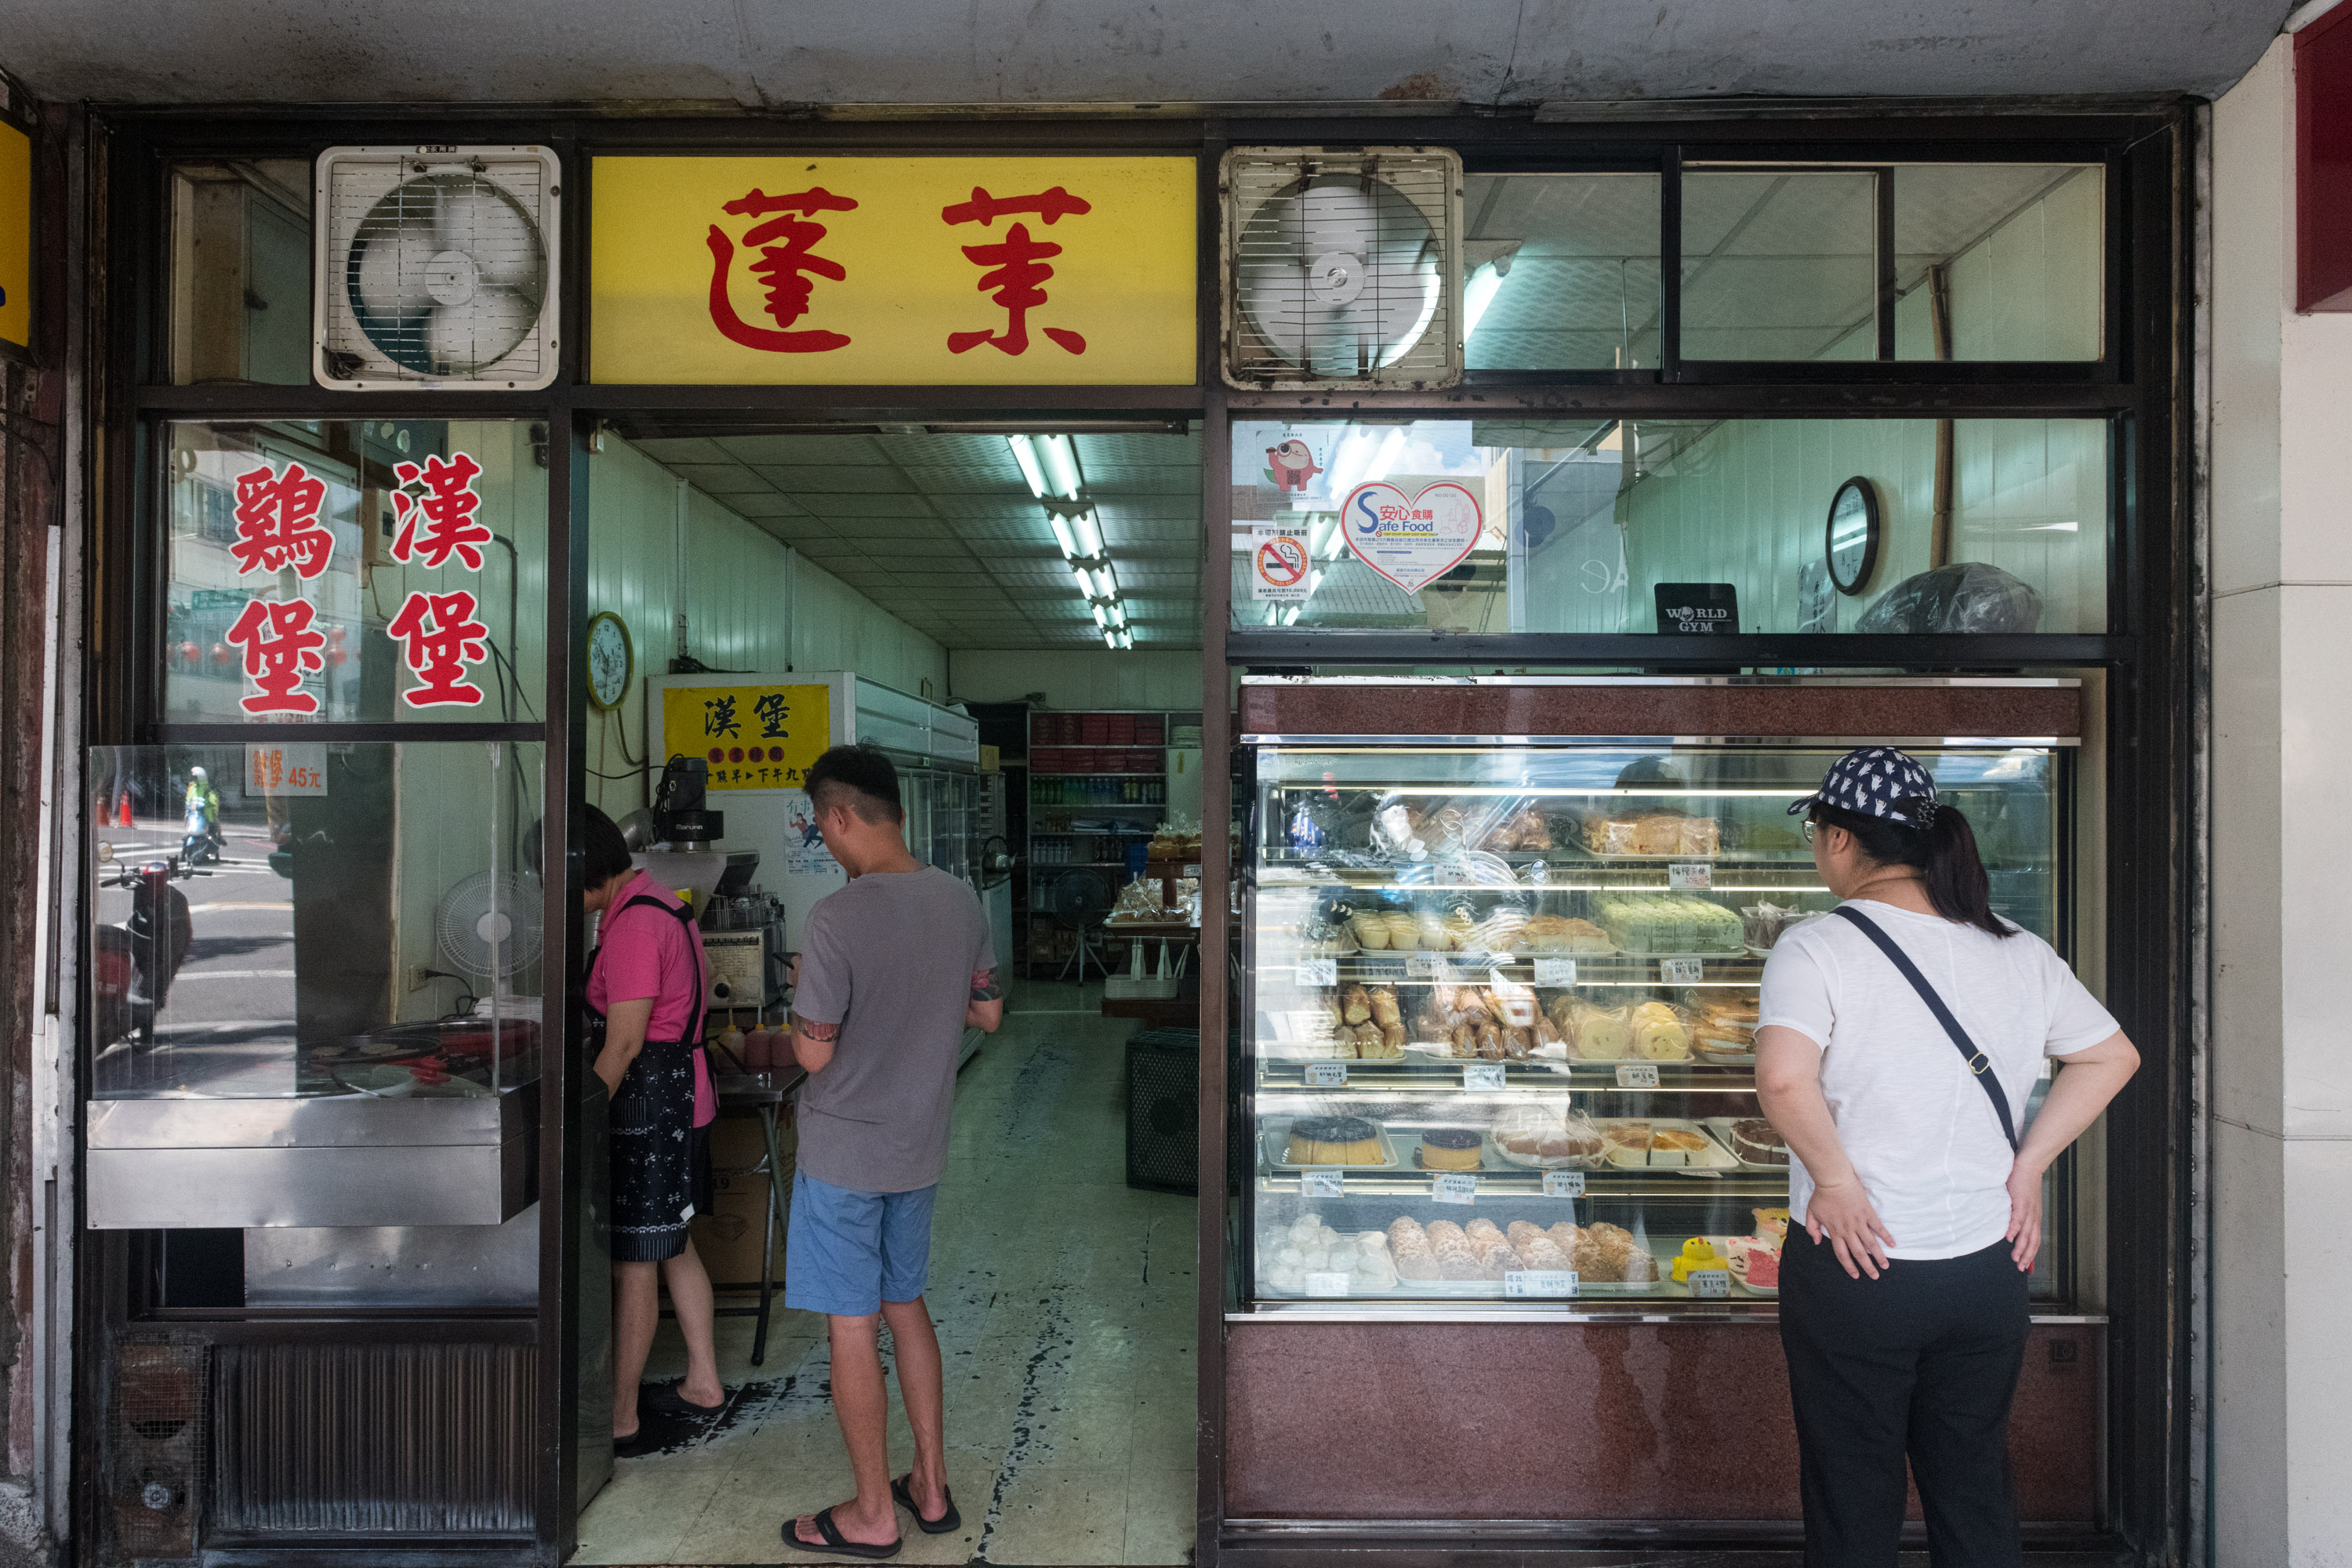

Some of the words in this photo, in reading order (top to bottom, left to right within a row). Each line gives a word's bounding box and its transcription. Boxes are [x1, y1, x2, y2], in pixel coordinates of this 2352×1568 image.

[1355, 491, 1399, 533] Safe
[1403, 521, 1433, 532] Food
[1380, 504, 1433, 521] 安心食購
[387, 452, 493, 709] 漢堡
[1679, 622, 1714, 632] GYM
[703, 693, 790, 739] 漢堡
